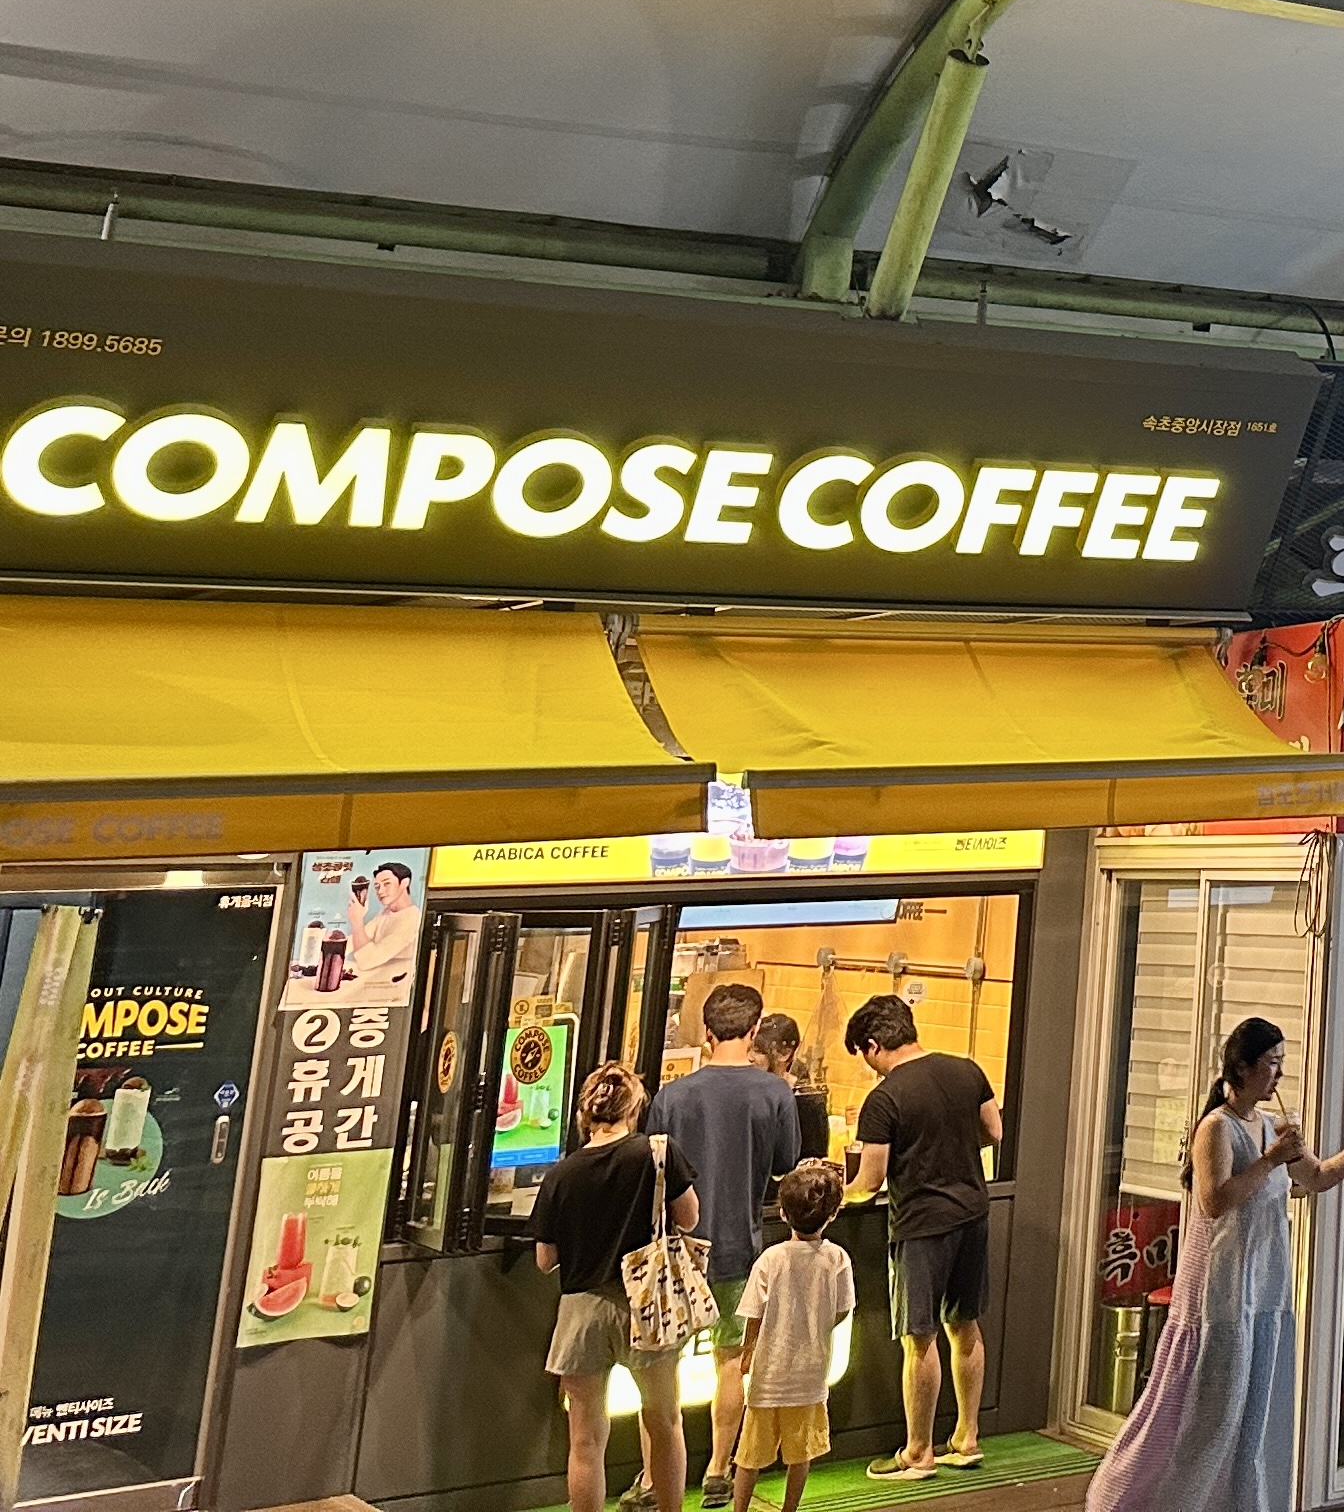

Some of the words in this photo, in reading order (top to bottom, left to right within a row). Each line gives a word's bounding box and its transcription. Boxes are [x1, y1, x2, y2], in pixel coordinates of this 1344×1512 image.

[42, 330, 163, 356] 1899.5685
[1142, 414, 1242, 437] 속초중앙시장점
[0, 396, 774, 544] COMPOSE
[777, 446, 1222, 563] COFFEE
[472, 845, 546, 862] ARABICA
[550, 845, 610, 861] COFFEE
[218, 894, 275, 910] 휴게음식점
[90, 987, 124, 999] OUT
[133, 986, 205, 1001] CULTURE
[80, 999, 210, 1039] MPOSE
[76, 1039, 156, 1060] COFFEE
[513, 1027, 551, 1053] COMPOSE
[513, 1062, 546, 1083] COFFEE
[1097, 1226, 1179, 1288] 흑미
[20, 1418, 90, 1446] VENTI
[91, 1412, 144, 1439] SIZE
